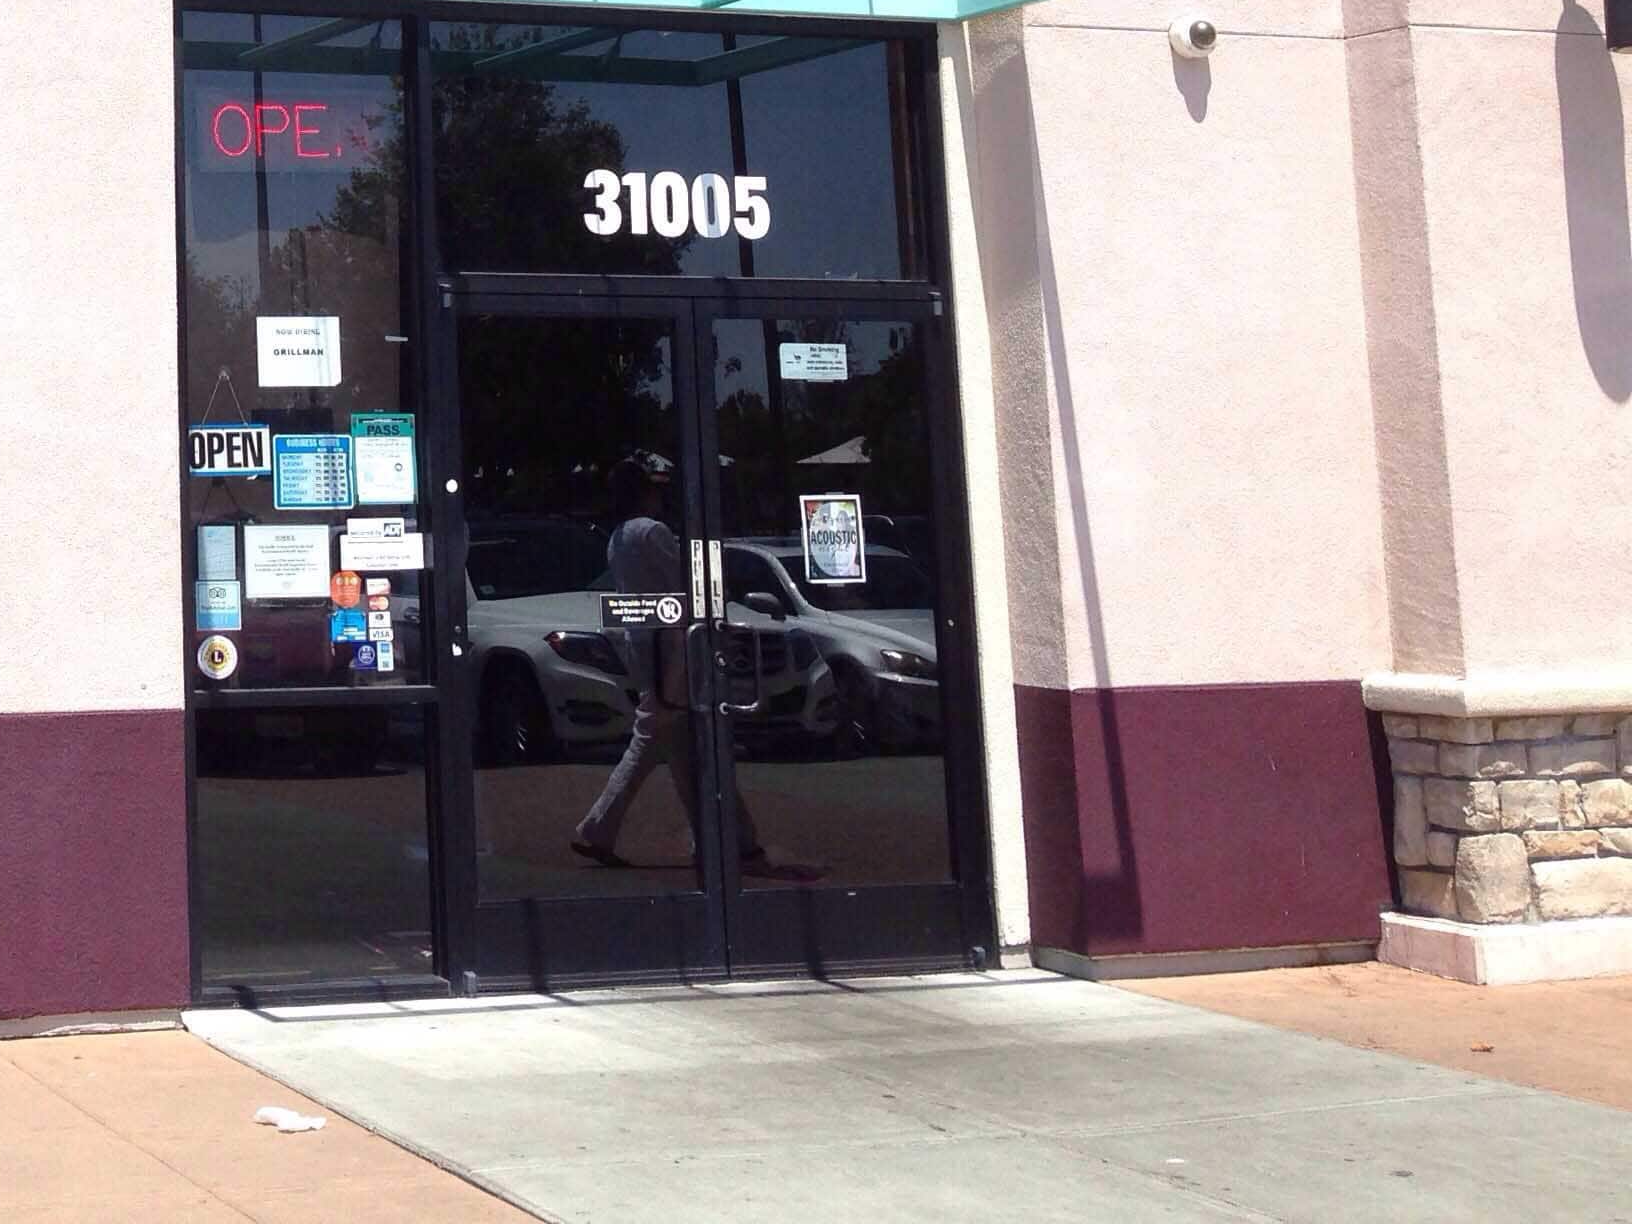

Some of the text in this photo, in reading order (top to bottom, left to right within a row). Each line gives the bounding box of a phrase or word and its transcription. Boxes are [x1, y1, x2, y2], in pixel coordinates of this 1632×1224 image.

[213, 103, 366, 158] OPE
[582, 169, 771, 240] 31005
[272, 348, 325, 357] GRILLMAN
[366, 424, 401, 436] PASS
[189, 430, 265, 470] OPEN
[810, 530, 857, 546] ACOUSTIC
[372, 630, 390, 639] VISA
